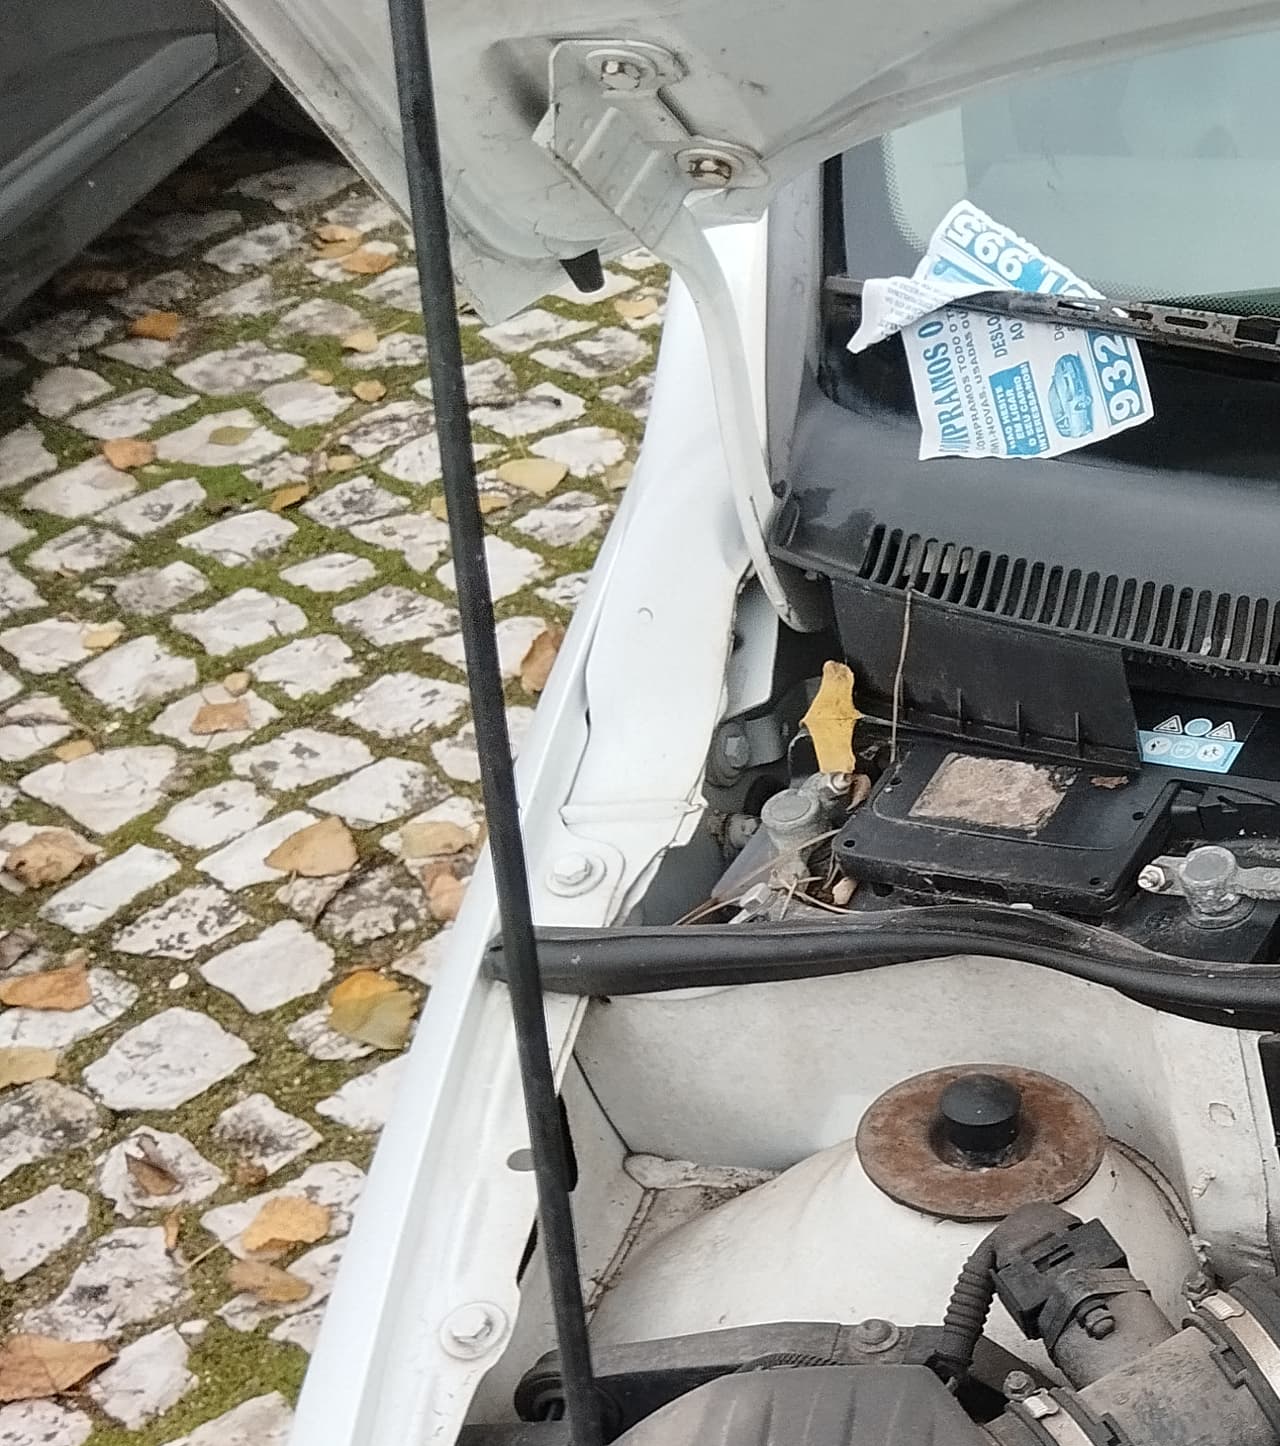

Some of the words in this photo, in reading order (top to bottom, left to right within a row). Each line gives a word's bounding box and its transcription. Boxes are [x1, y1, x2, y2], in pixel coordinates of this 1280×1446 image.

[917, 321, 944, 338] O
[951, 336, 968, 373] TODO
[965, 332, 982, 384] USADAS
[1093, 334, 1141, 420] 932
